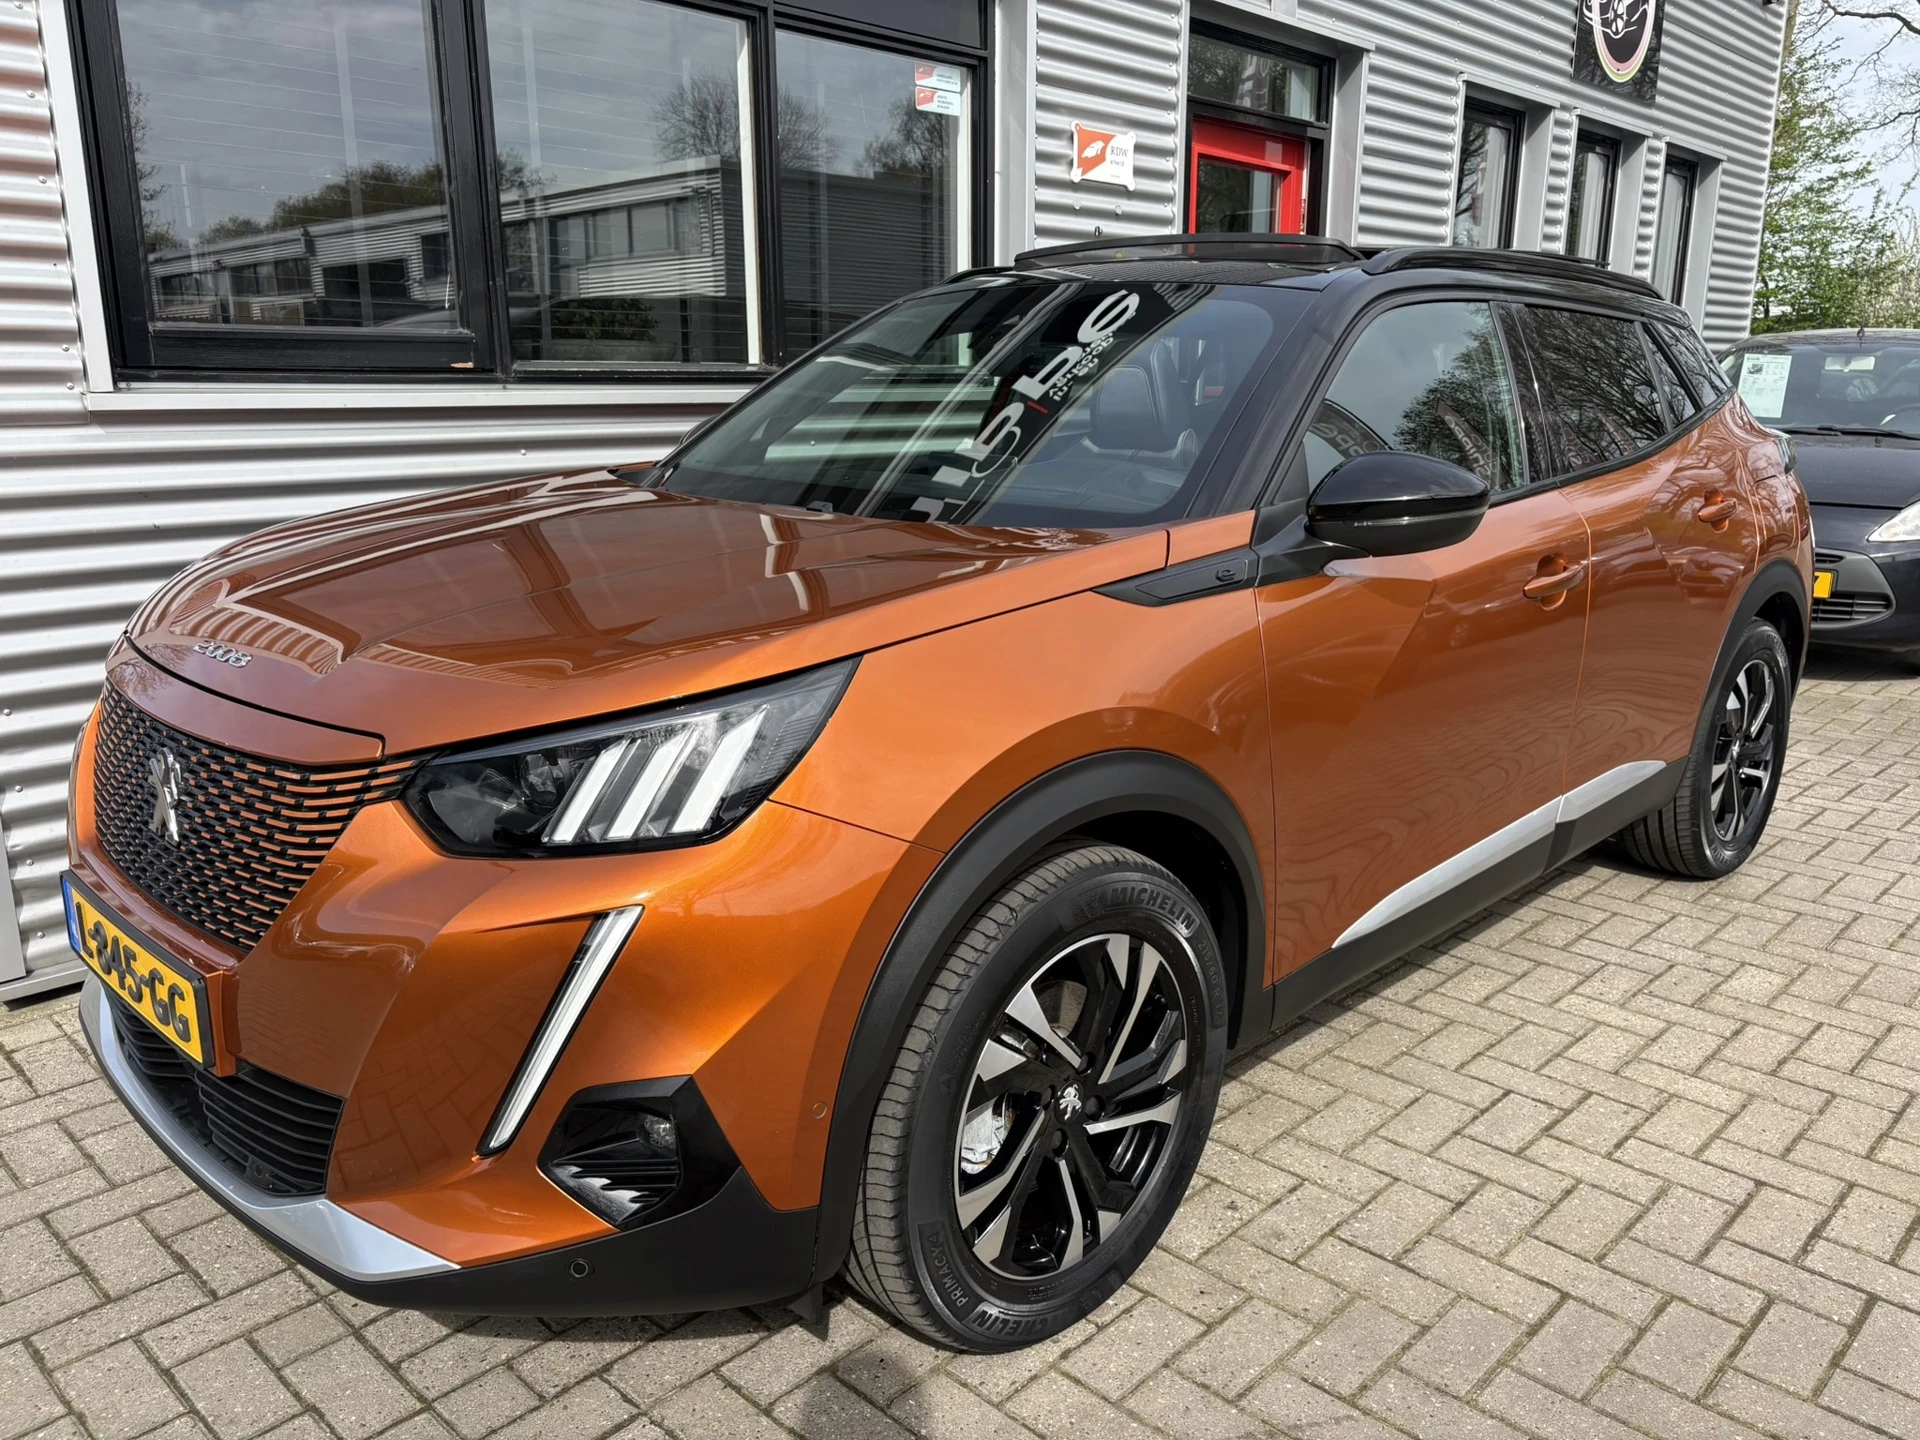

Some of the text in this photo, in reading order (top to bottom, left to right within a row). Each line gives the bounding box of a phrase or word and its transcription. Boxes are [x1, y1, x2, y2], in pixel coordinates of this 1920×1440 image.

[1110, 146, 1129, 157] RDW
[193, 640, 253, 668] 2008
[1107, 886, 1196, 931] MICHELIN
[75, 901, 191, 1043] L-845-GG
[928, 1232, 970, 1308] PRIMACY 4
